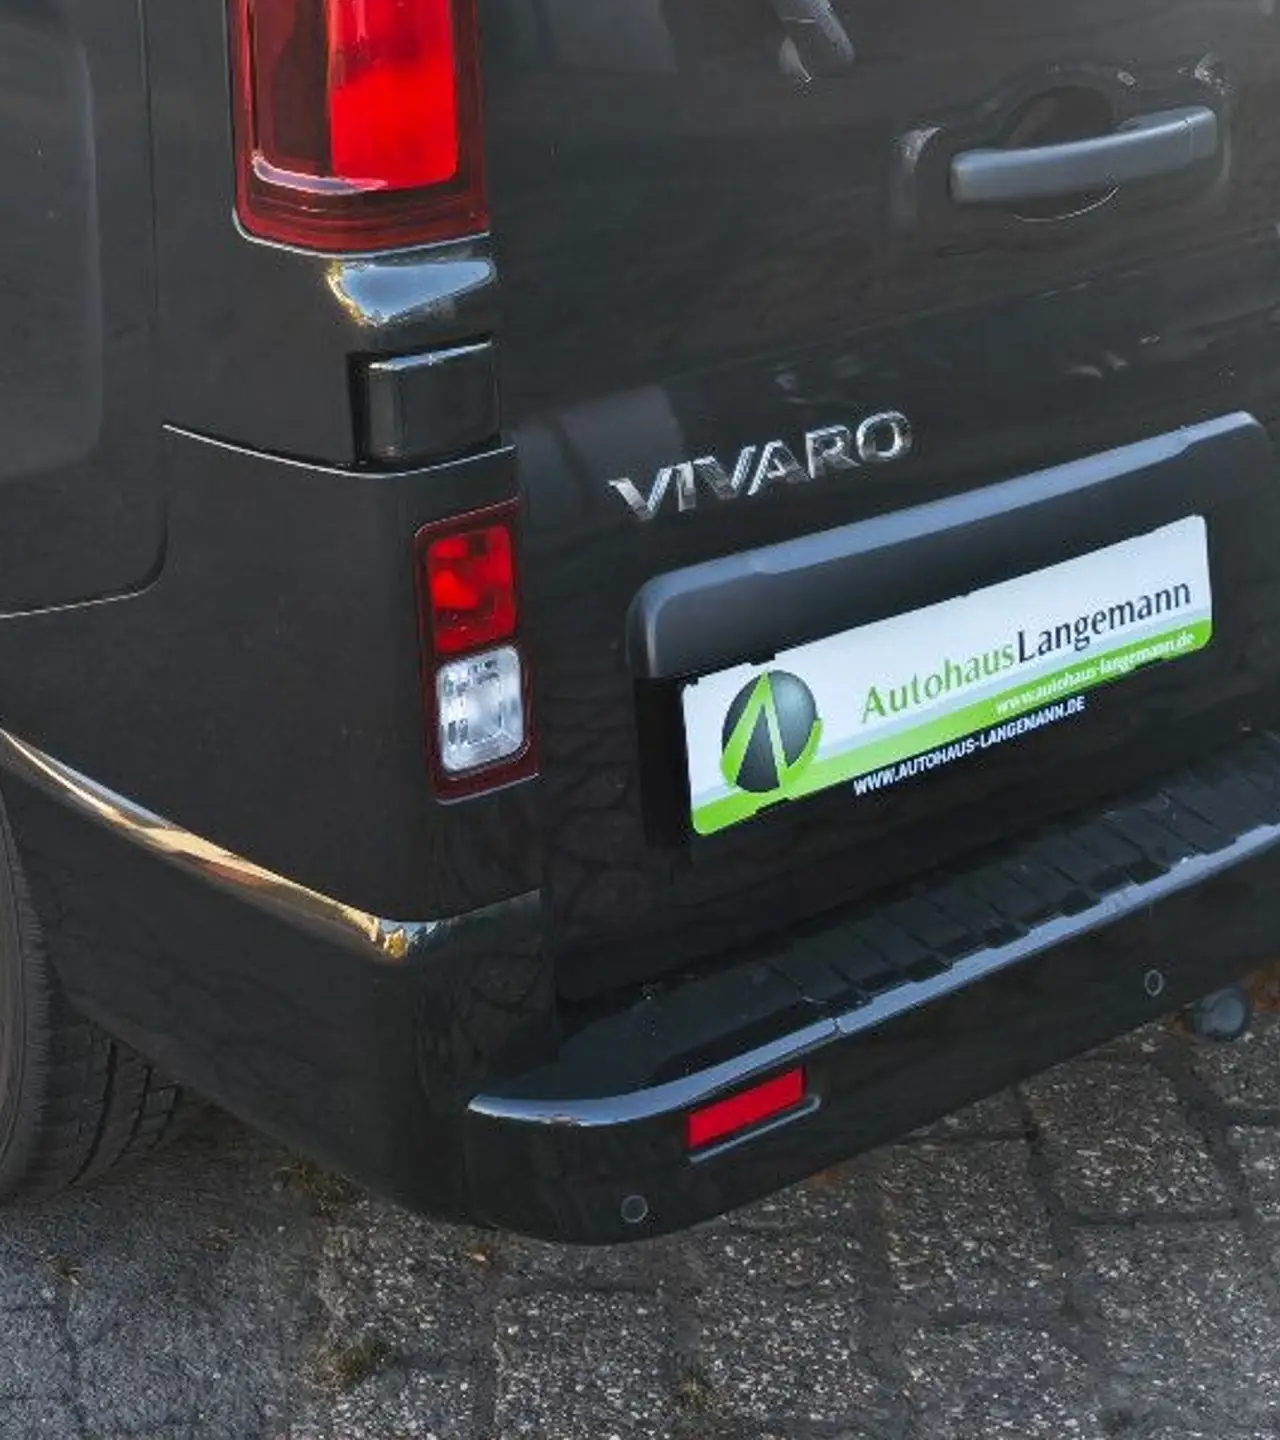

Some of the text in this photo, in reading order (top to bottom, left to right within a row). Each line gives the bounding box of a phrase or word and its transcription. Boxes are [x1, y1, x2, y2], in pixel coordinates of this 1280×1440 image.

[608, 410, 912, 520] VIVARO
[995, 630, 1196, 717] www.autohaus-langemann.de
[853, 695, 1087, 797] WWW.AUTOHAUS-LANGEMANN.DE
